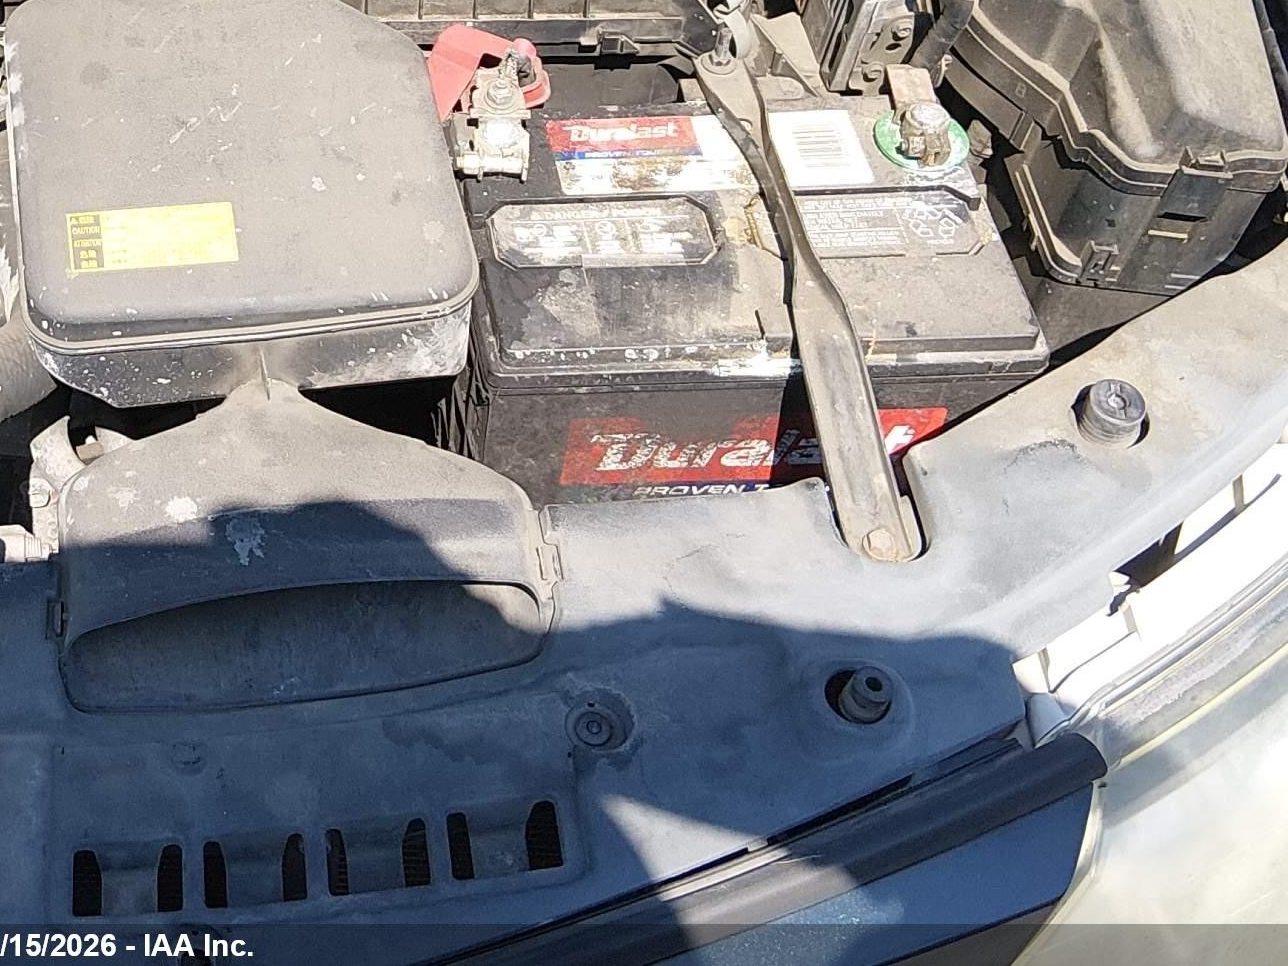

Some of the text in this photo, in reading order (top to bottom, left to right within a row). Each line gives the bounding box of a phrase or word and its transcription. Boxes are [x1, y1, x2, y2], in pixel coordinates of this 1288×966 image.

[562, 121, 679, 142] Duralast
[72, 225, 100, 235] CAUTION
[632, 484, 744, 496] PROVEN
